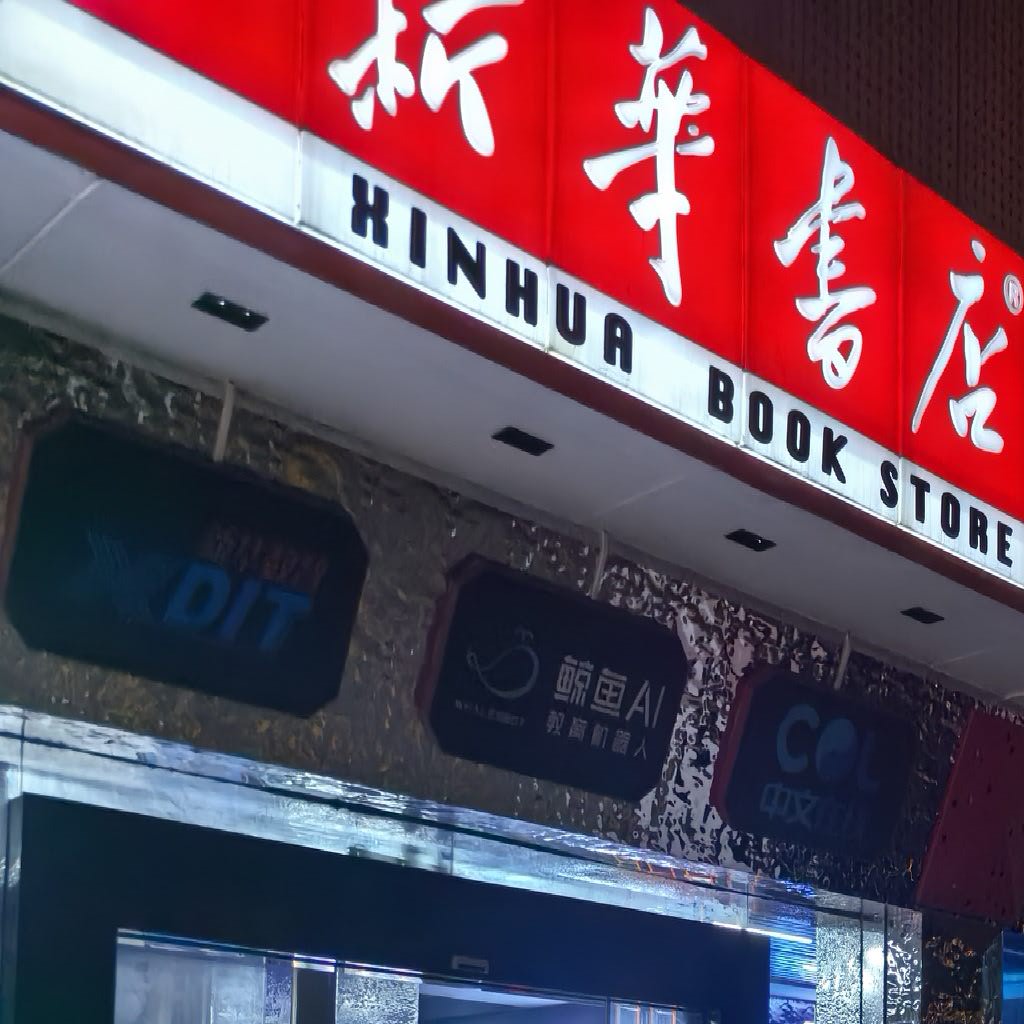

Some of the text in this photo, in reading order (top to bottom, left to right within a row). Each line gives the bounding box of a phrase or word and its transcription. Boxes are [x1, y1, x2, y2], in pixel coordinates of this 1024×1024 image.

[350, 173, 1014, 569] XINHUA BOOK STORE
[759, 781, 872, 836] 中文
